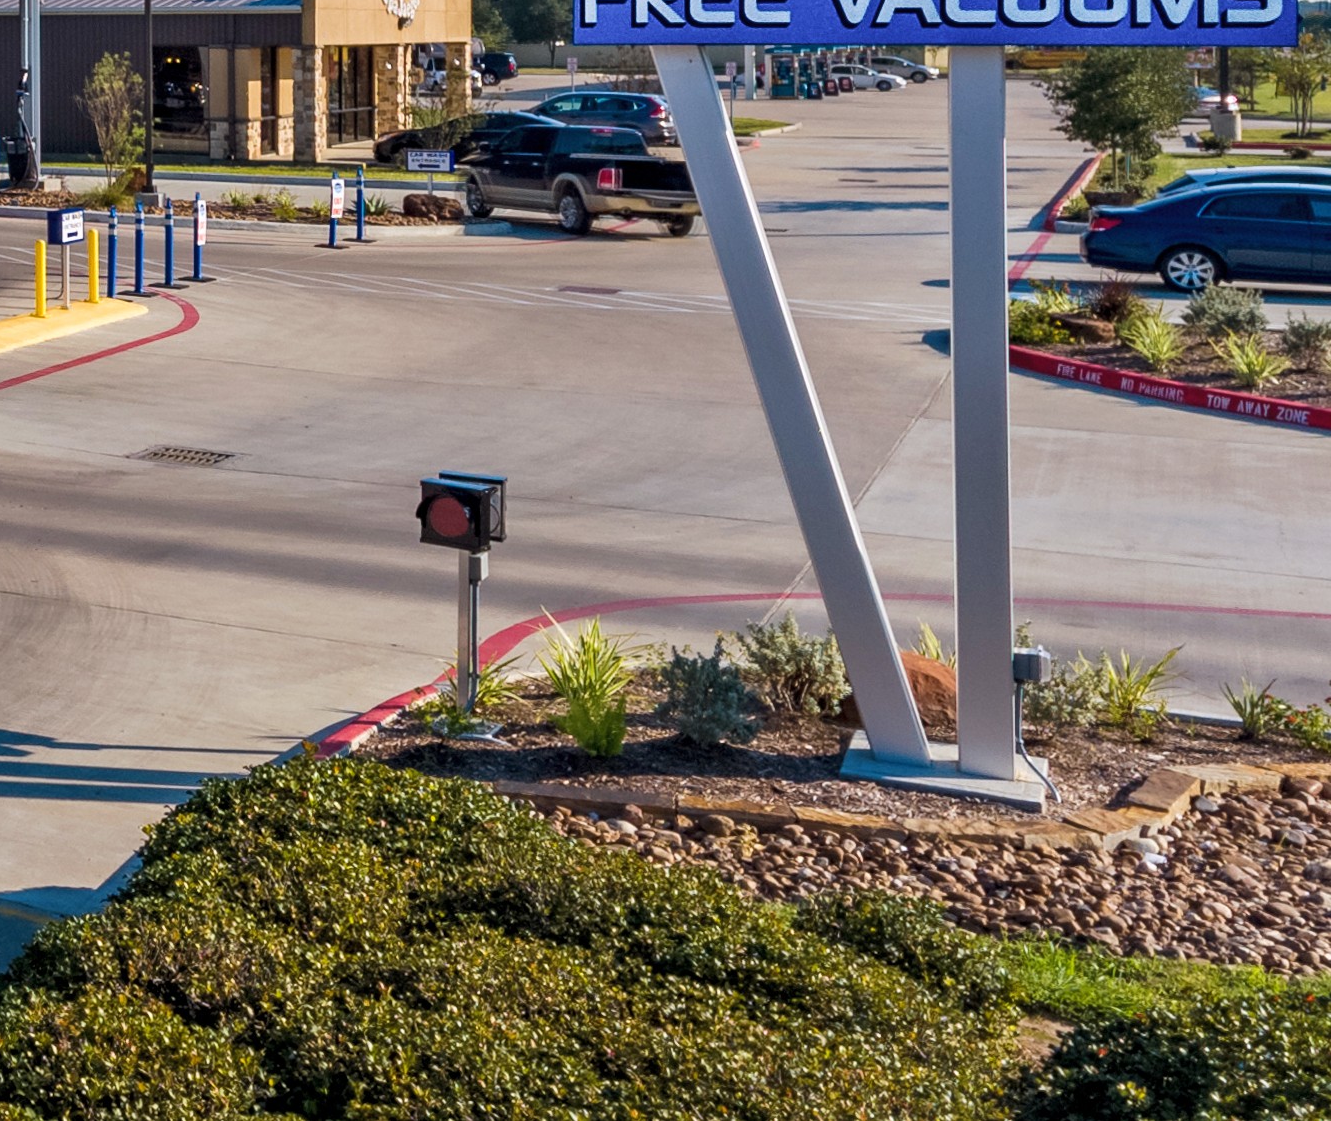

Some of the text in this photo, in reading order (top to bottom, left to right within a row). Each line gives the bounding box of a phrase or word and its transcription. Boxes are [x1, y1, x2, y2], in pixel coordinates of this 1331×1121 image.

[1056, 363, 1311, 425] FIRE LANE NO PARKING TOW AWAY ZONE
